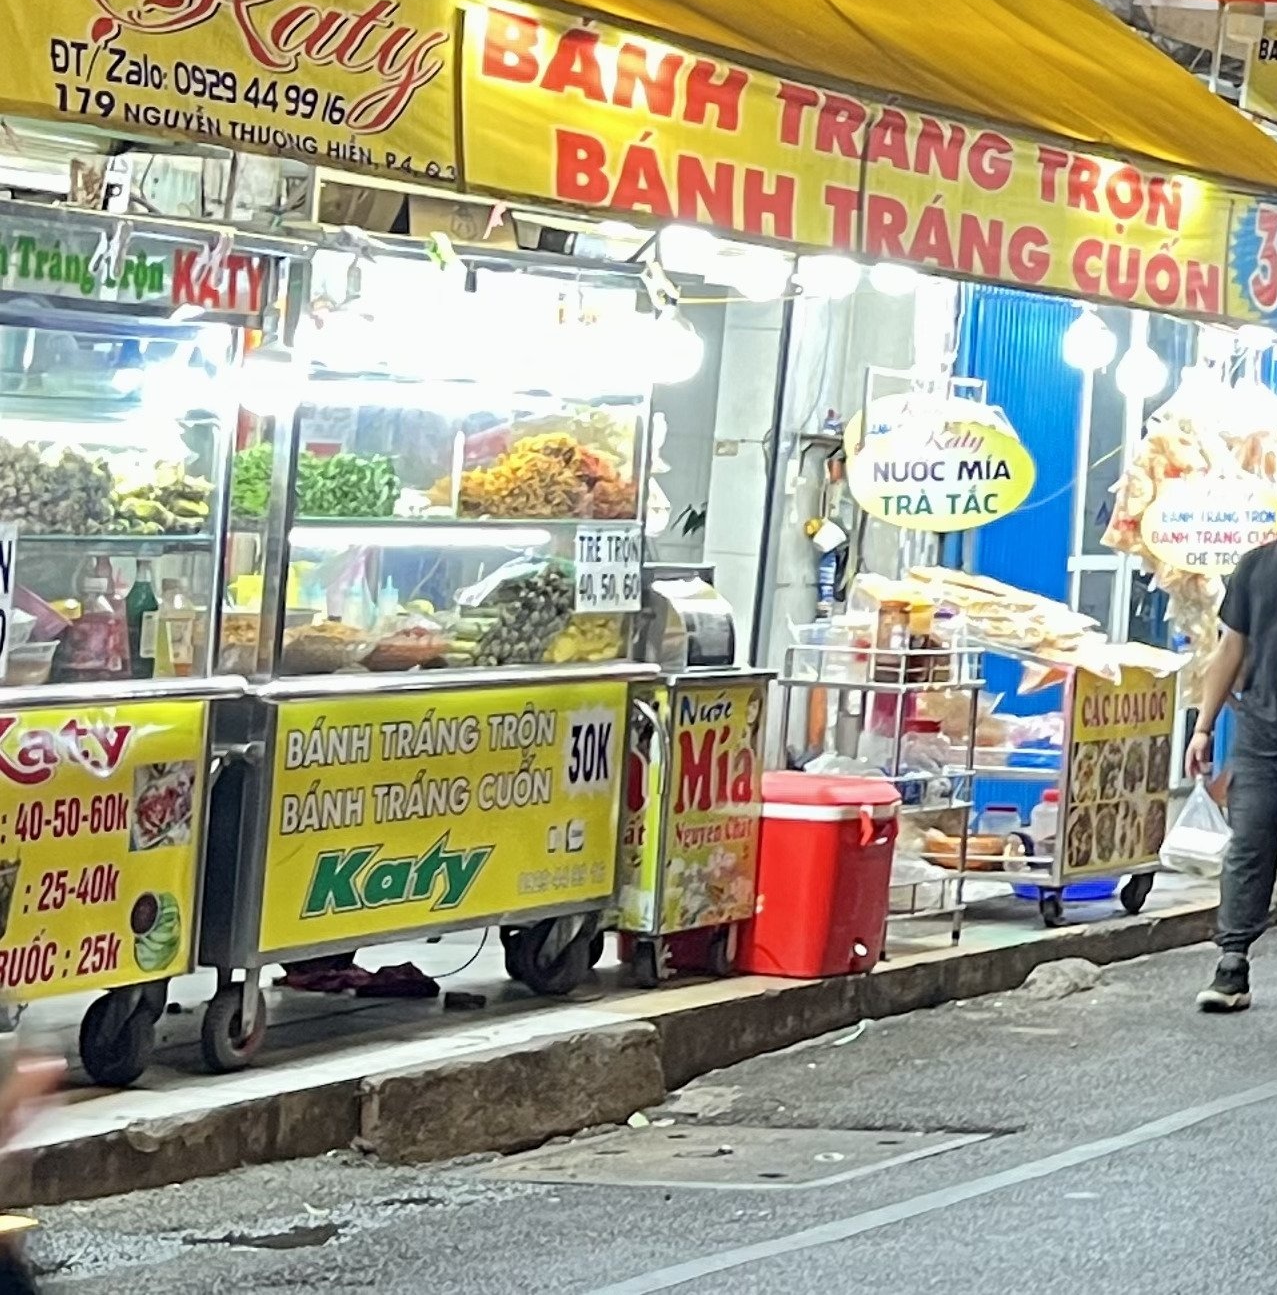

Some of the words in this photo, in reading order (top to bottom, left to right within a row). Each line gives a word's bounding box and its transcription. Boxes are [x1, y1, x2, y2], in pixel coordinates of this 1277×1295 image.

[174, 60, 237, 104] 0929
[243, 77, 279, 114] 44
[284, 84, 319, 121] 99
[480, 4, 750, 133] BÁNH
[54, 82, 116, 118] 179
[553, 126, 797, 242] BÁNH
[820, 186, 1053, 287] TRÁNG
[1071, 229, 1223, 316] CUỐN
[957, 454, 1012, 481] MÍA
[879, 488, 934, 516] TRÀ
[945, 484, 999, 515] TẮC
[284, 715, 371, 771] BÁNH
[380, 707, 480, 761] TRÁNG
[567, 721, 613, 784] 30K
[673, 725, 754, 815] Mía
[14, 792, 129, 843] 40-50-60k
[279, 778, 363, 836] BÁNH
[372, 768, 470, 824] TRÁNG
[477, 755, 552, 811] CUỐN
[37, 863, 121, 912] 25-40k
[299, 827, 497, 921] Katy
[76, 931, 122, 977] 25k
